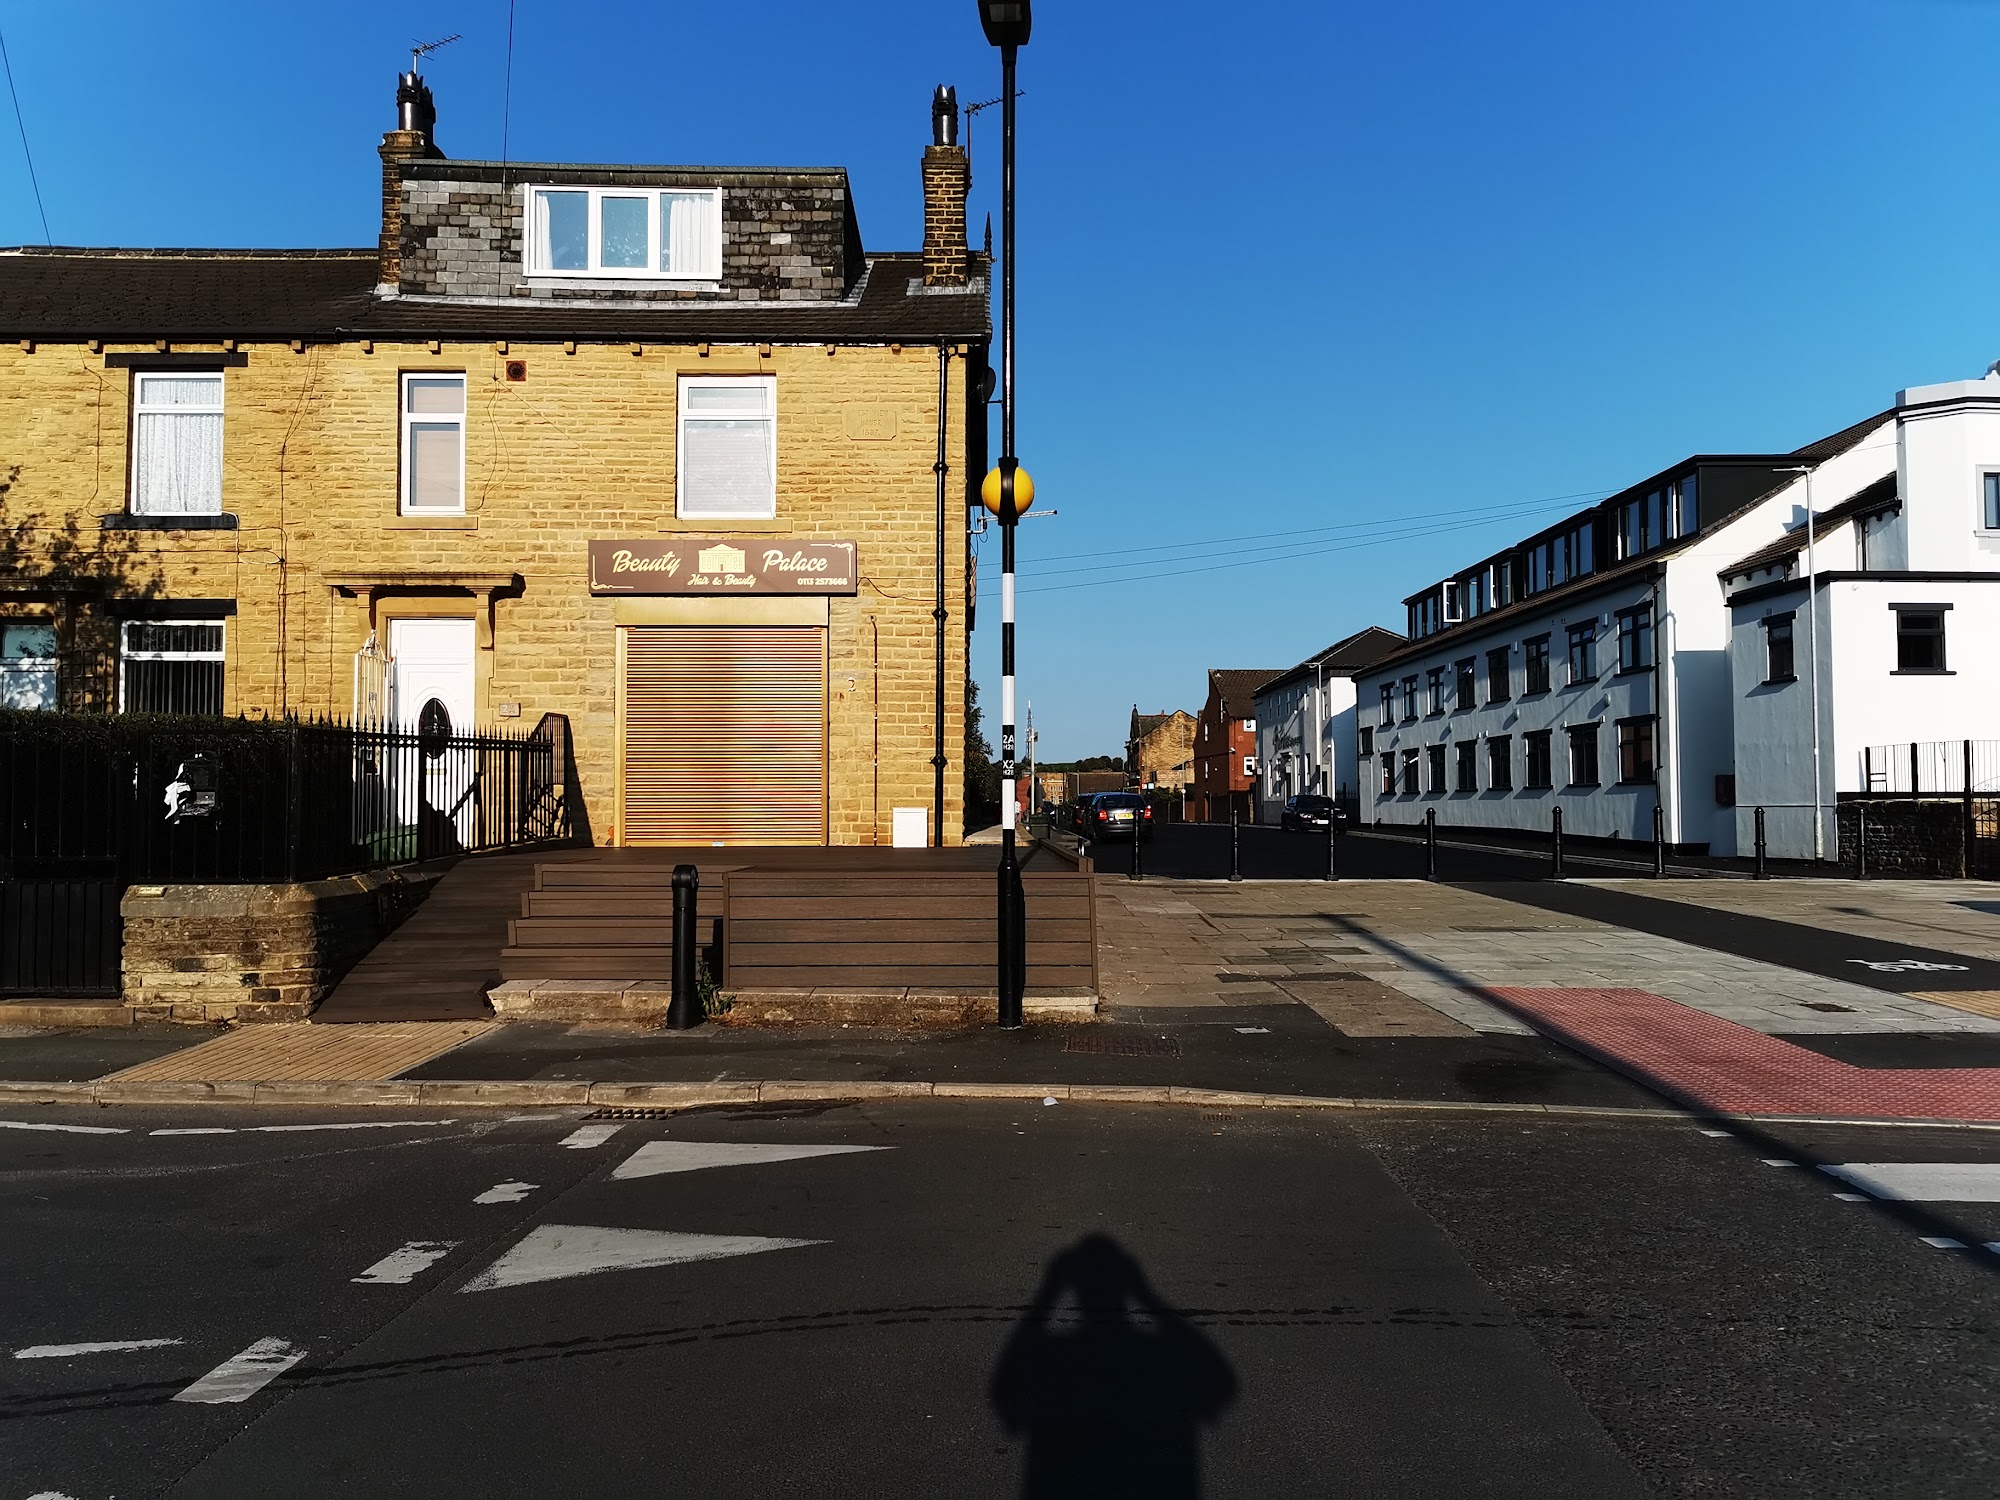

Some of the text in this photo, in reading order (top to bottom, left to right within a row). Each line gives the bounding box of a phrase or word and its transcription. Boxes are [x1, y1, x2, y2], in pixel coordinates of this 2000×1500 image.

[612, 549, 828, 578] Beauty Palace
[687, 573, 757, 588] Hair & Beauty
[797, 577, 848, 586] 0113 2573666
[1003, 735, 1014, 744] 2A
[1003, 760, 1014, 769] X2
